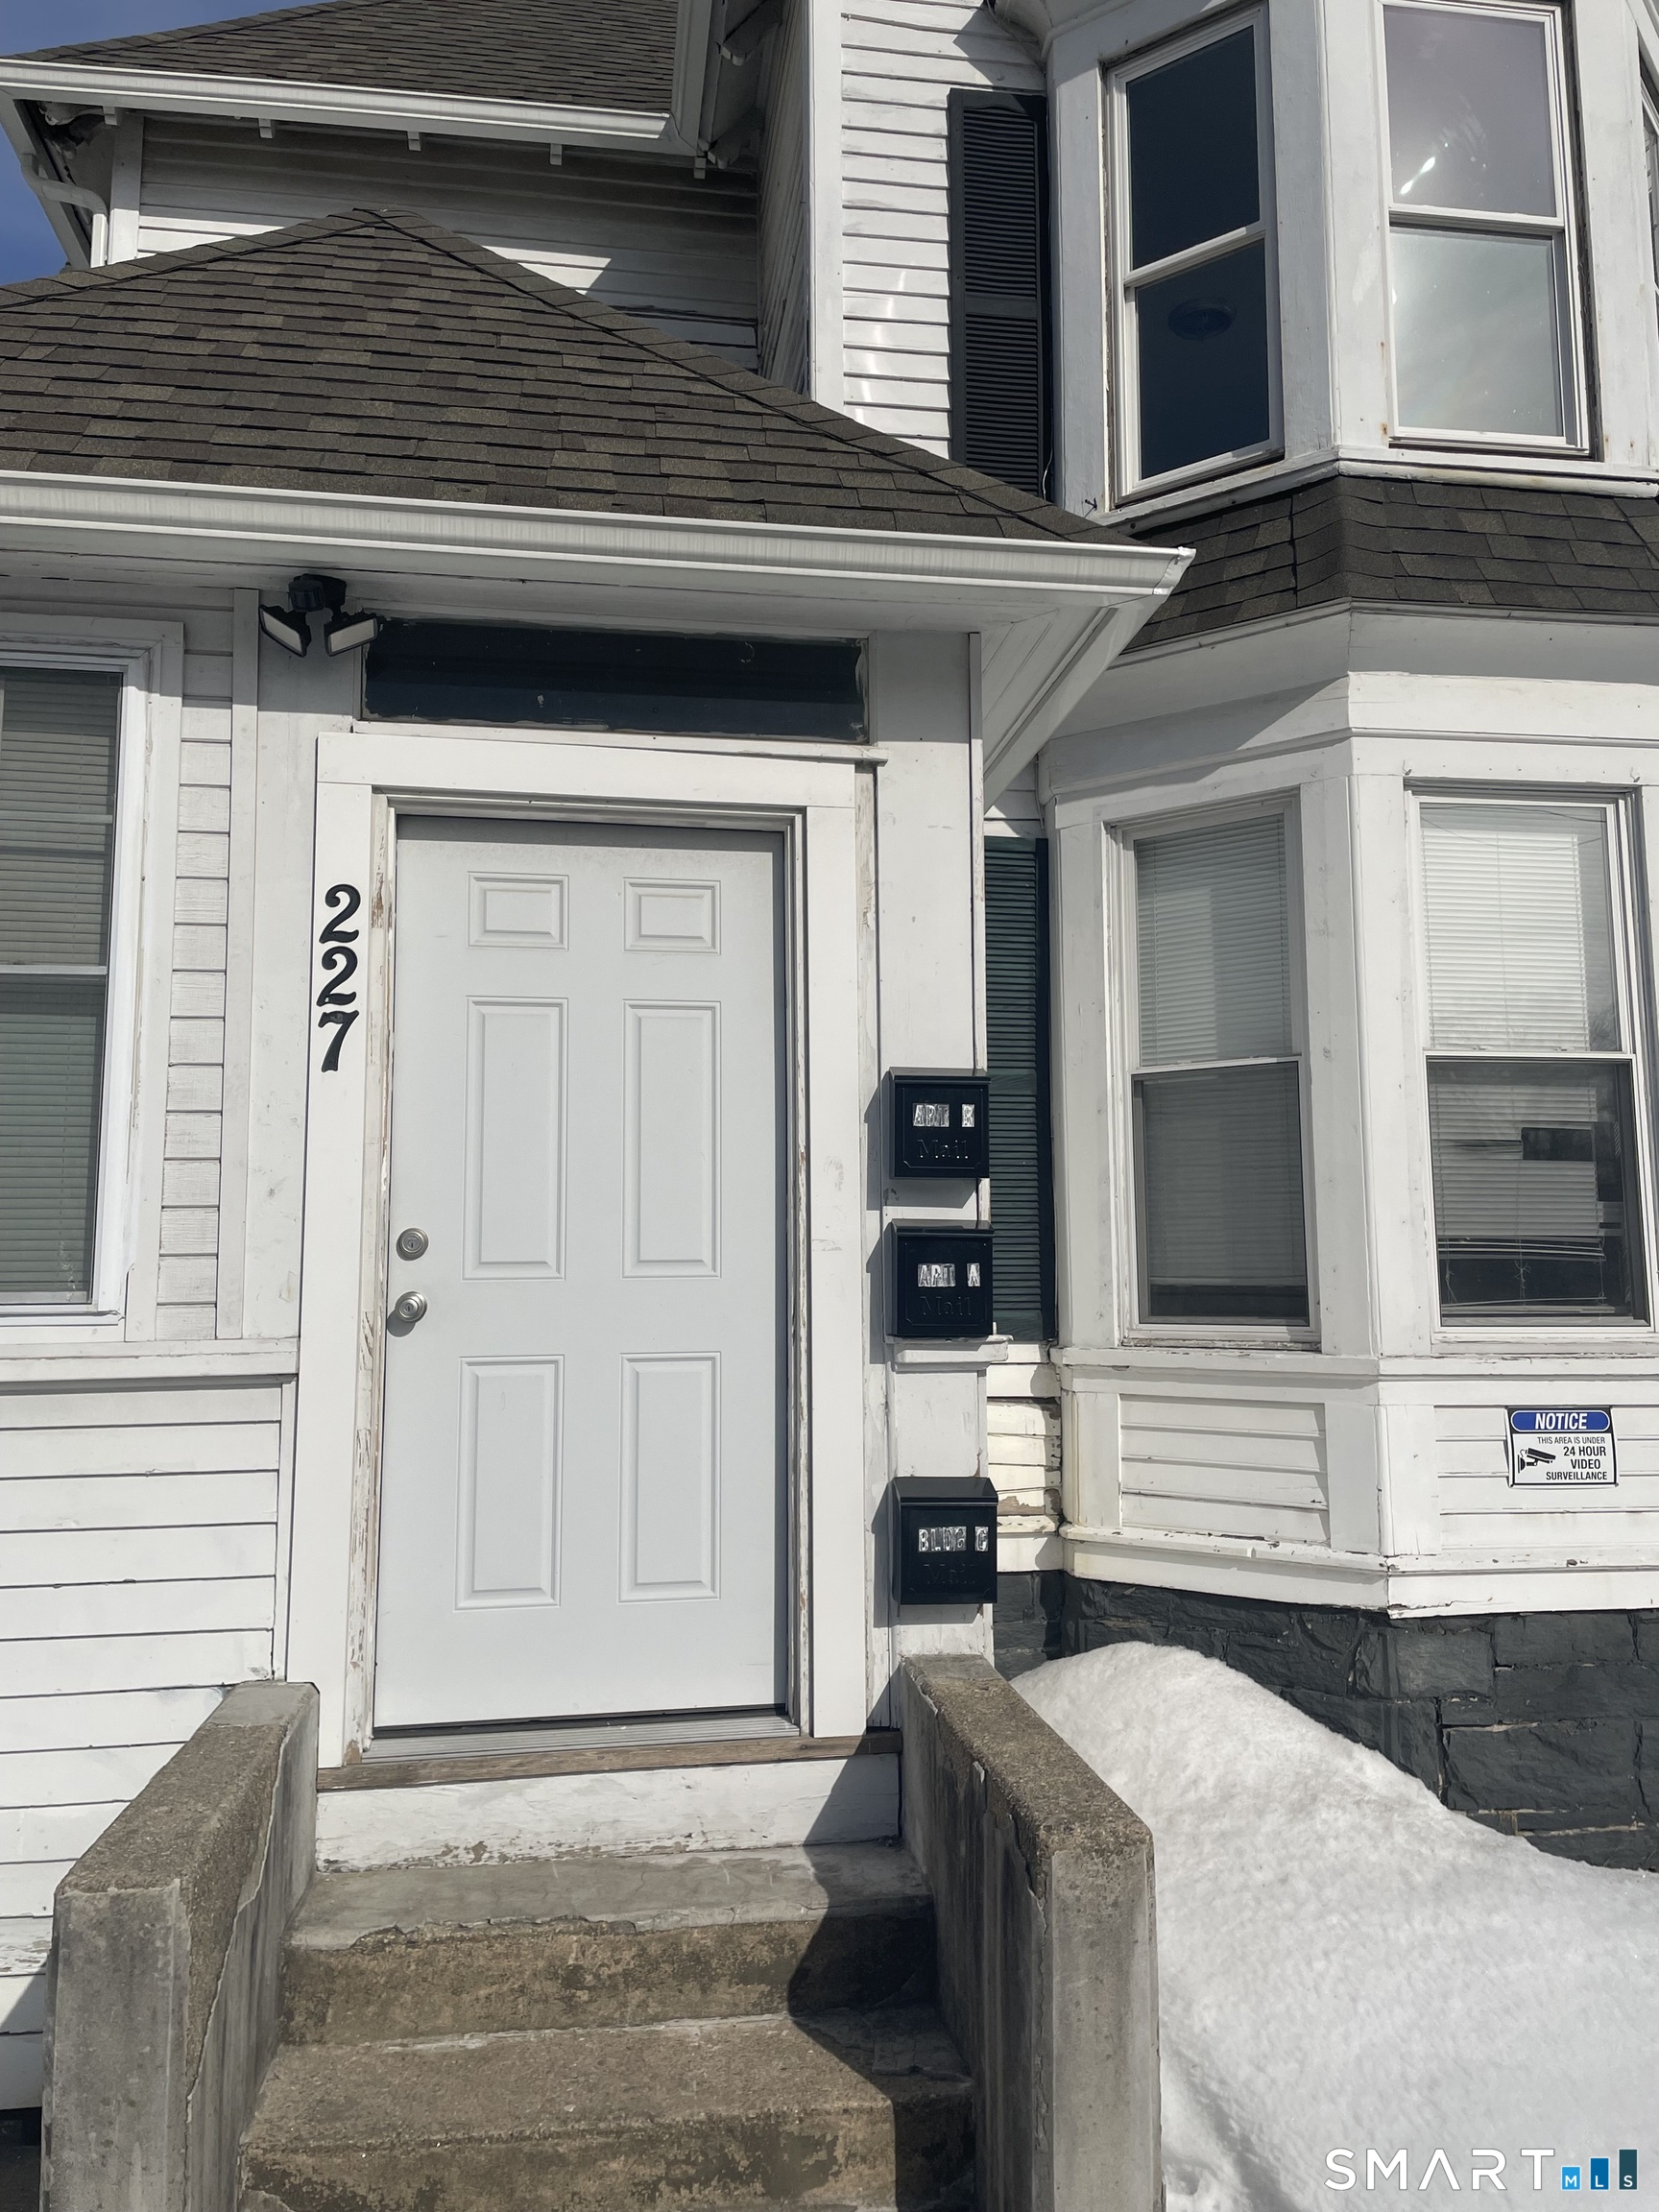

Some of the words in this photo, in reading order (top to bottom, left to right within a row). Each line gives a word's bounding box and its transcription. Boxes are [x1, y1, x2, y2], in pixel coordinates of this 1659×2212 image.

[316, 883, 361, 1072] 227
[914, 1104, 950, 1126] APT
[917, 1140, 969, 1159] Mail
[919, 1263, 955, 1286] APT
[968, 1263, 980, 1286] A
[920, 1296, 972, 1315] Mail
[1535, 1413, 1587, 1430] NOTICE
[1563, 1446, 1575, 1456] 24
[1578, 1446, 1606, 1456] HOUR
[1571, 1459, 1600, 1469] VIDEO
[1546, 1472, 1607, 1480] SURVEILLANCE
